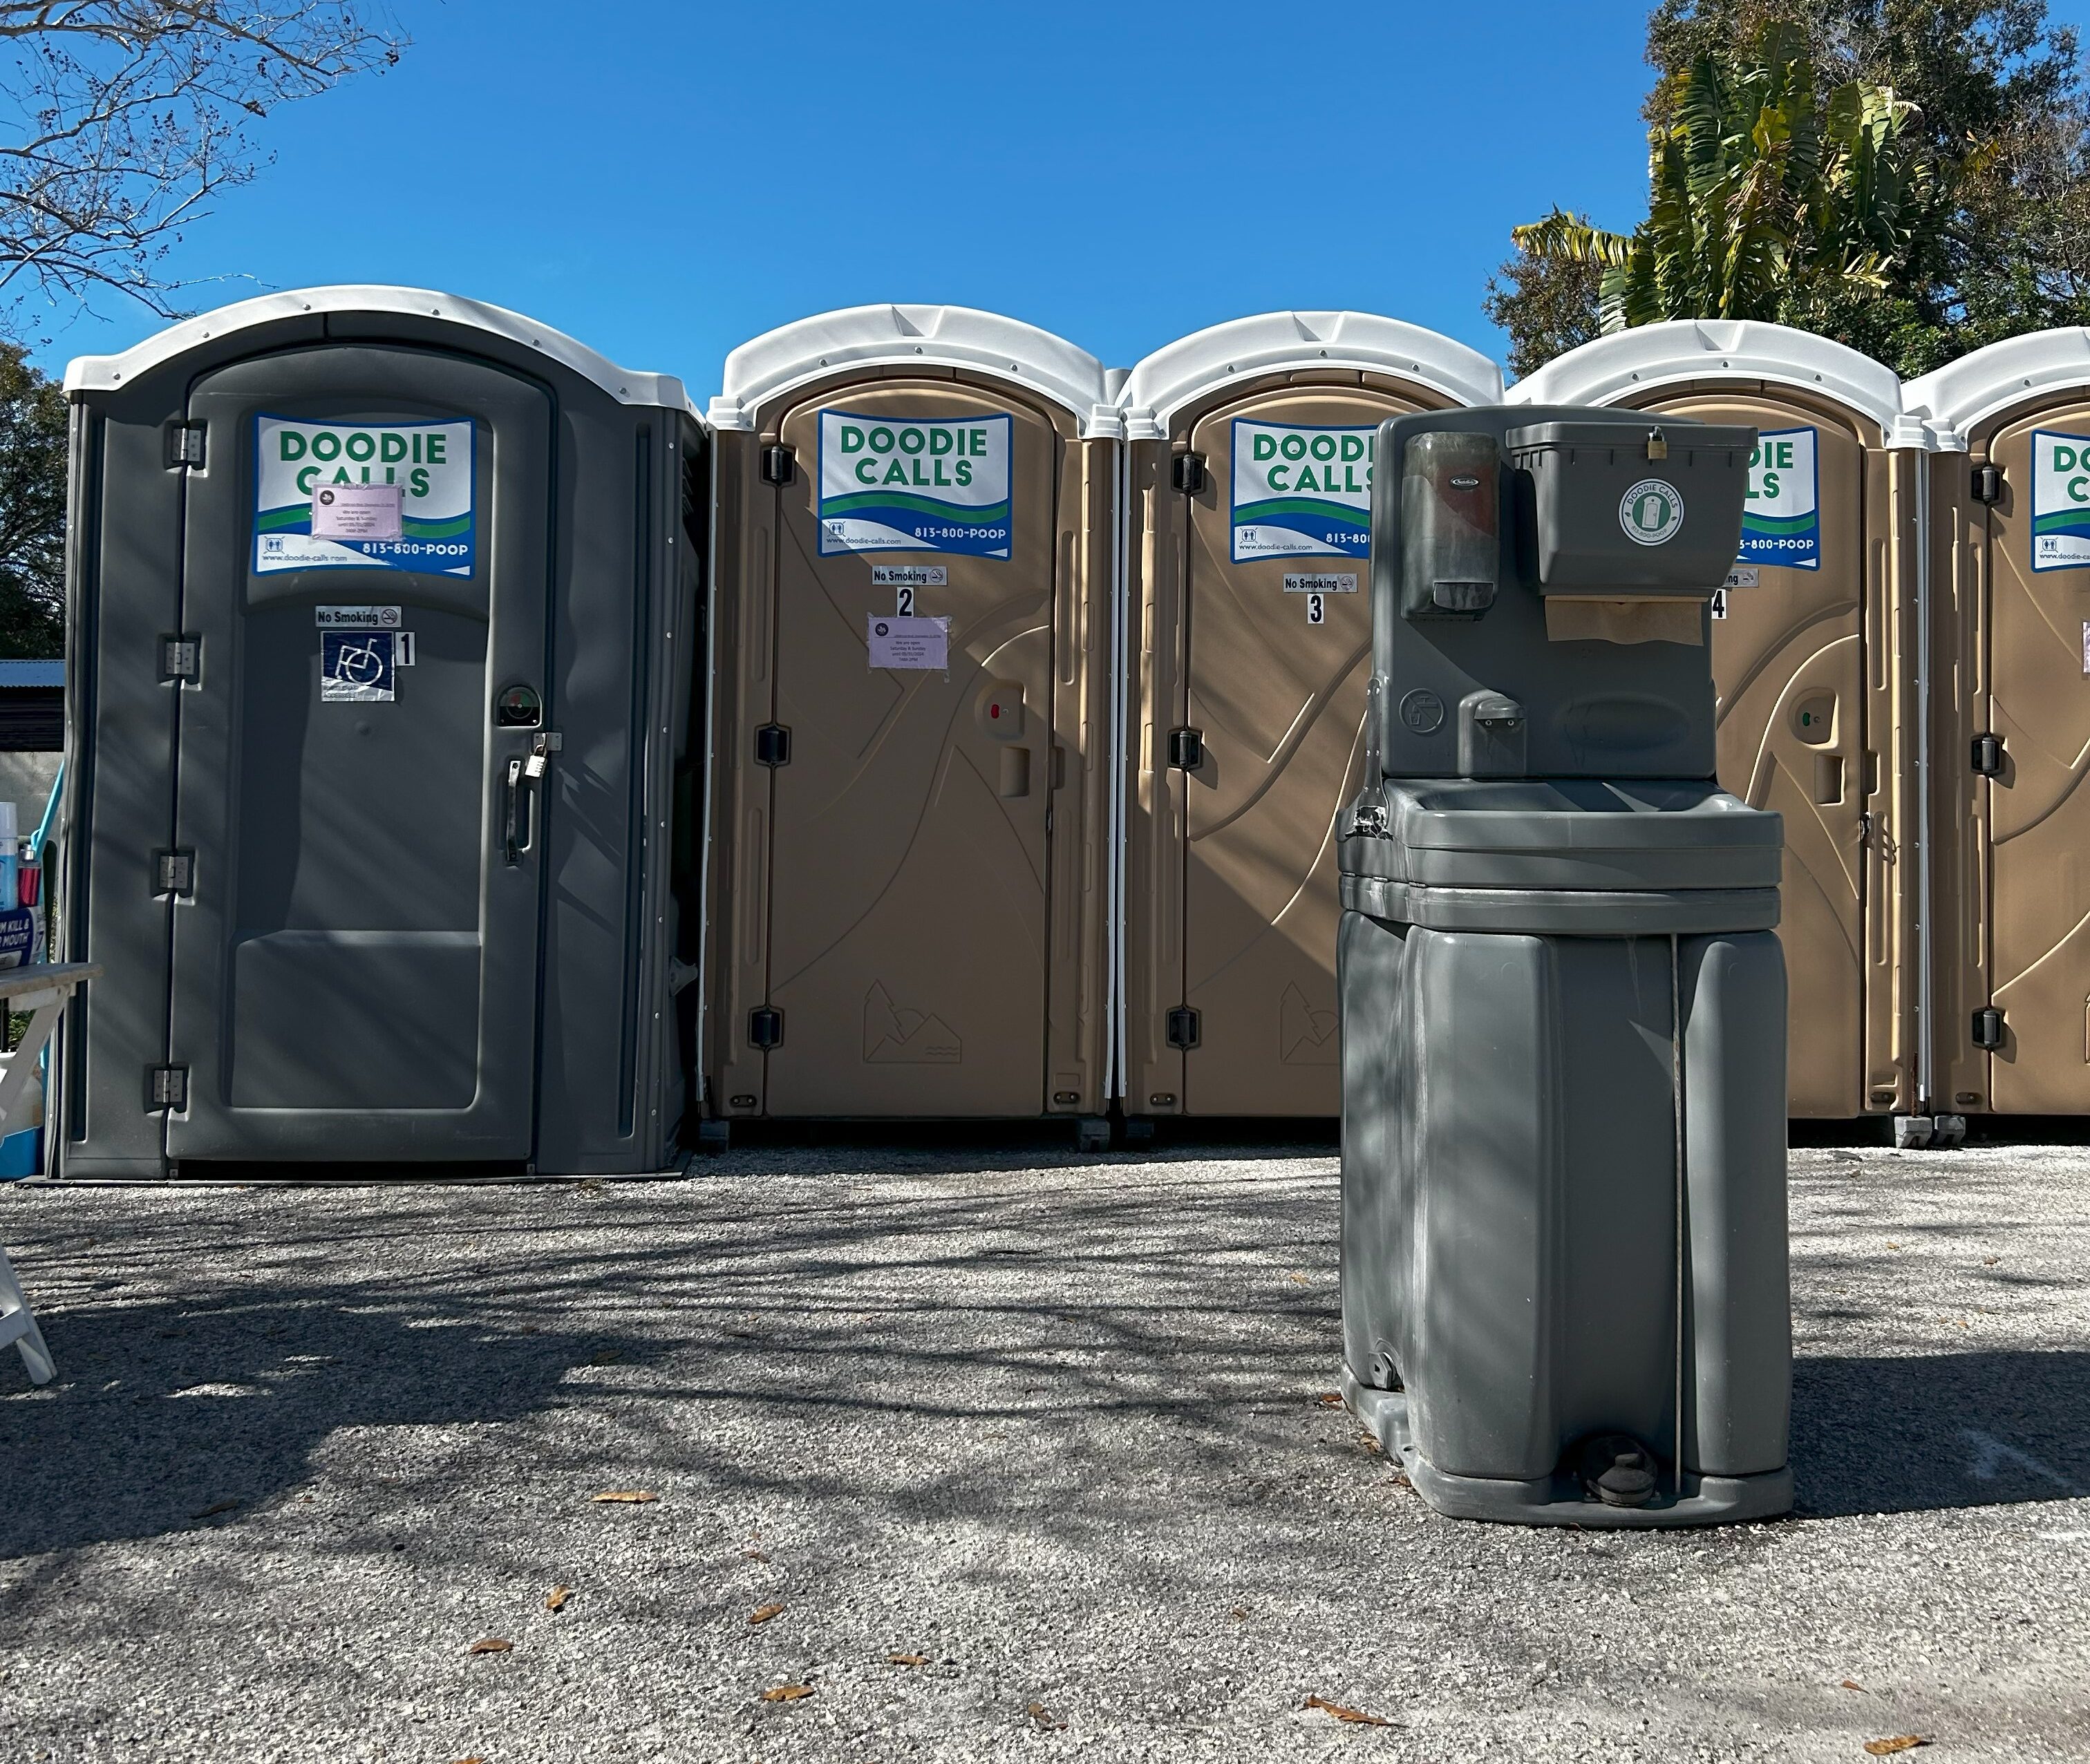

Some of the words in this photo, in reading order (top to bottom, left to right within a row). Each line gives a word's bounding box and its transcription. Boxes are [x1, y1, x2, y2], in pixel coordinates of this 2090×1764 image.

[281, 430, 446, 464] DOODIE
[841, 426, 987, 457] DOODIE
[1254, 434, 1374, 462] DOODI
[855, 457, 972, 486] CALLS
[1627, 484, 1657, 505] DOODIE
[1659, 486, 1678, 509] CALLS
[827, 537, 901, 545] www.doodie-calls.com
[914, 527, 1006, 540] 813-800-POOP
[1326, 533, 1370, 544] 813-80
[1740, 540, 1814, 549] 3-800-POOP
[874, 571, 886, 581] No
[888, 571, 927, 584] Smoking
[1285, 578, 1297, 588] No
[1299, 578, 1337, 591] Smoking
[899, 589, 912, 616] 2
[1310, 596, 1322, 623] 3
[1712, 590, 1724, 618] 4
[318, 611, 332, 623] No
[335, 611, 379, 625] Smoking
[401, 634, 411, 665] 1
